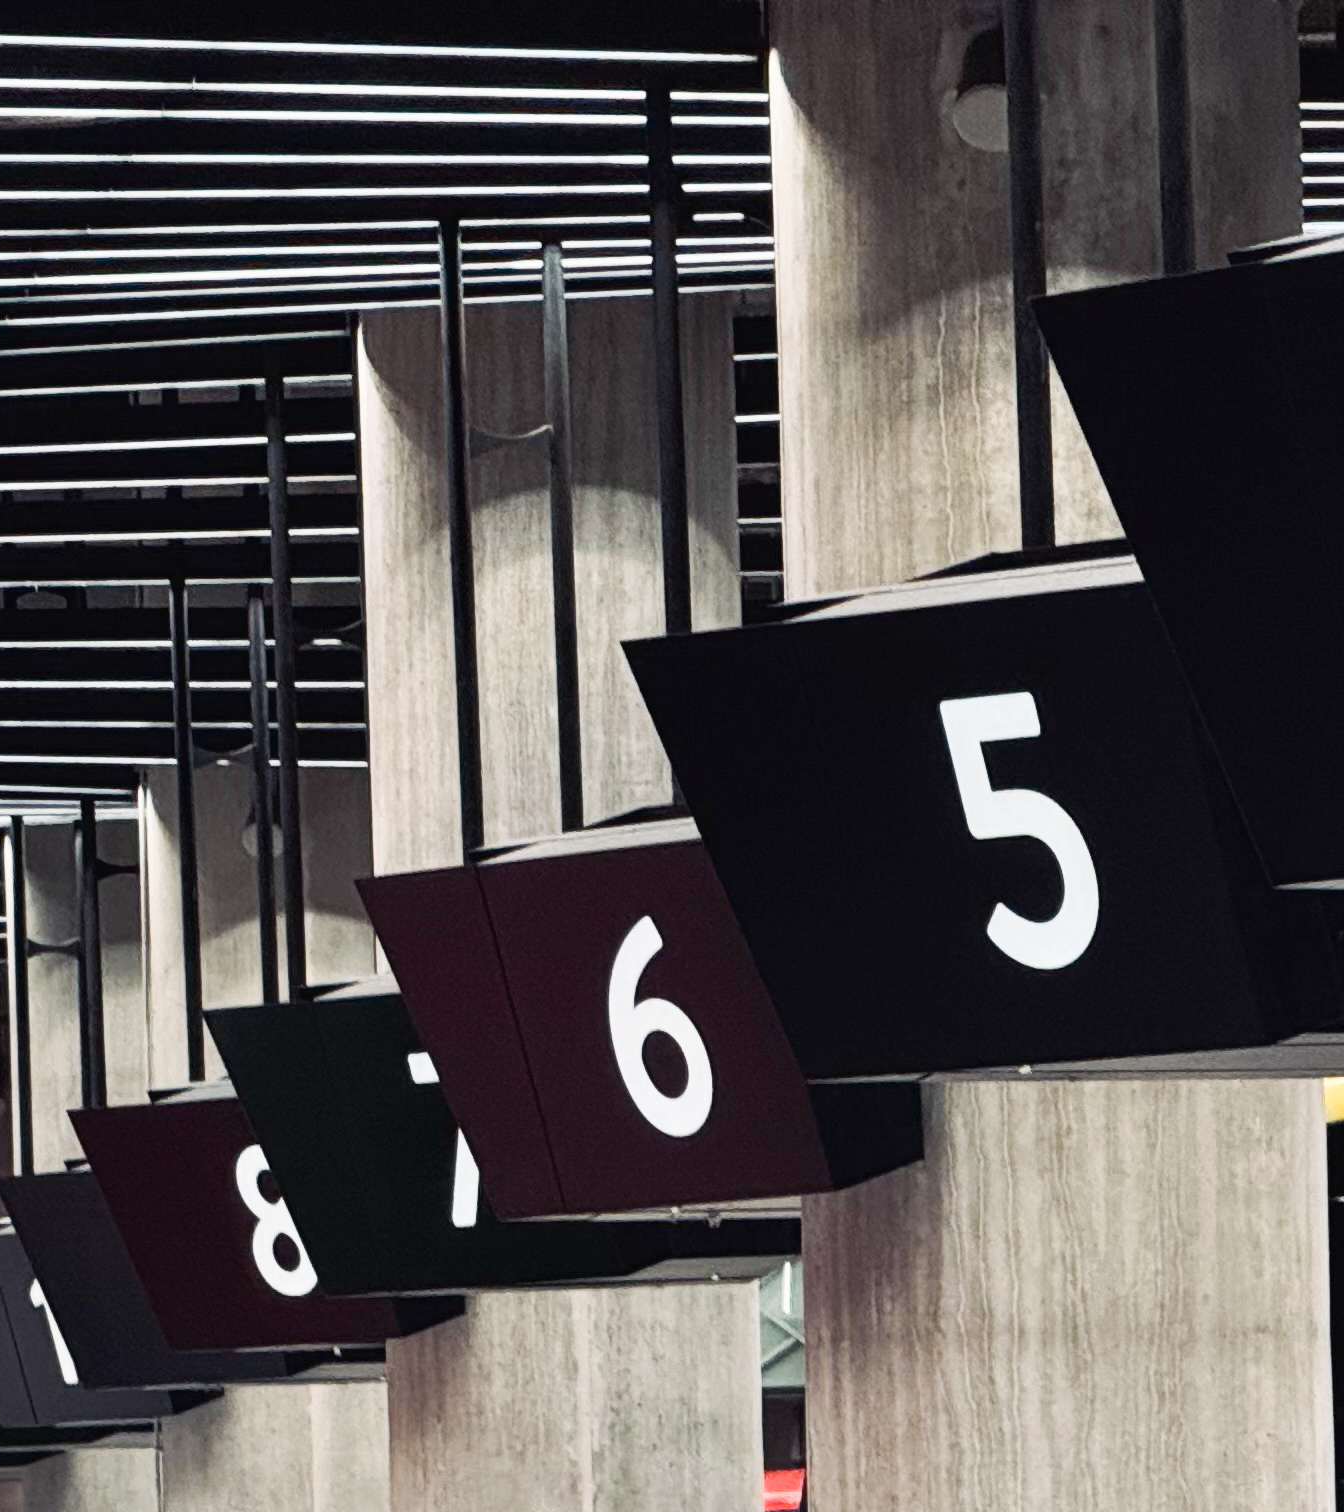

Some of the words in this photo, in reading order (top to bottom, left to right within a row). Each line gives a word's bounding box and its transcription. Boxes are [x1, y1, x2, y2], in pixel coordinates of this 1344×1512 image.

[938, 690, 1100, 970] 5
[608, 915, 713, 1138] 6
[235, 1144, 318, 1297] 8
